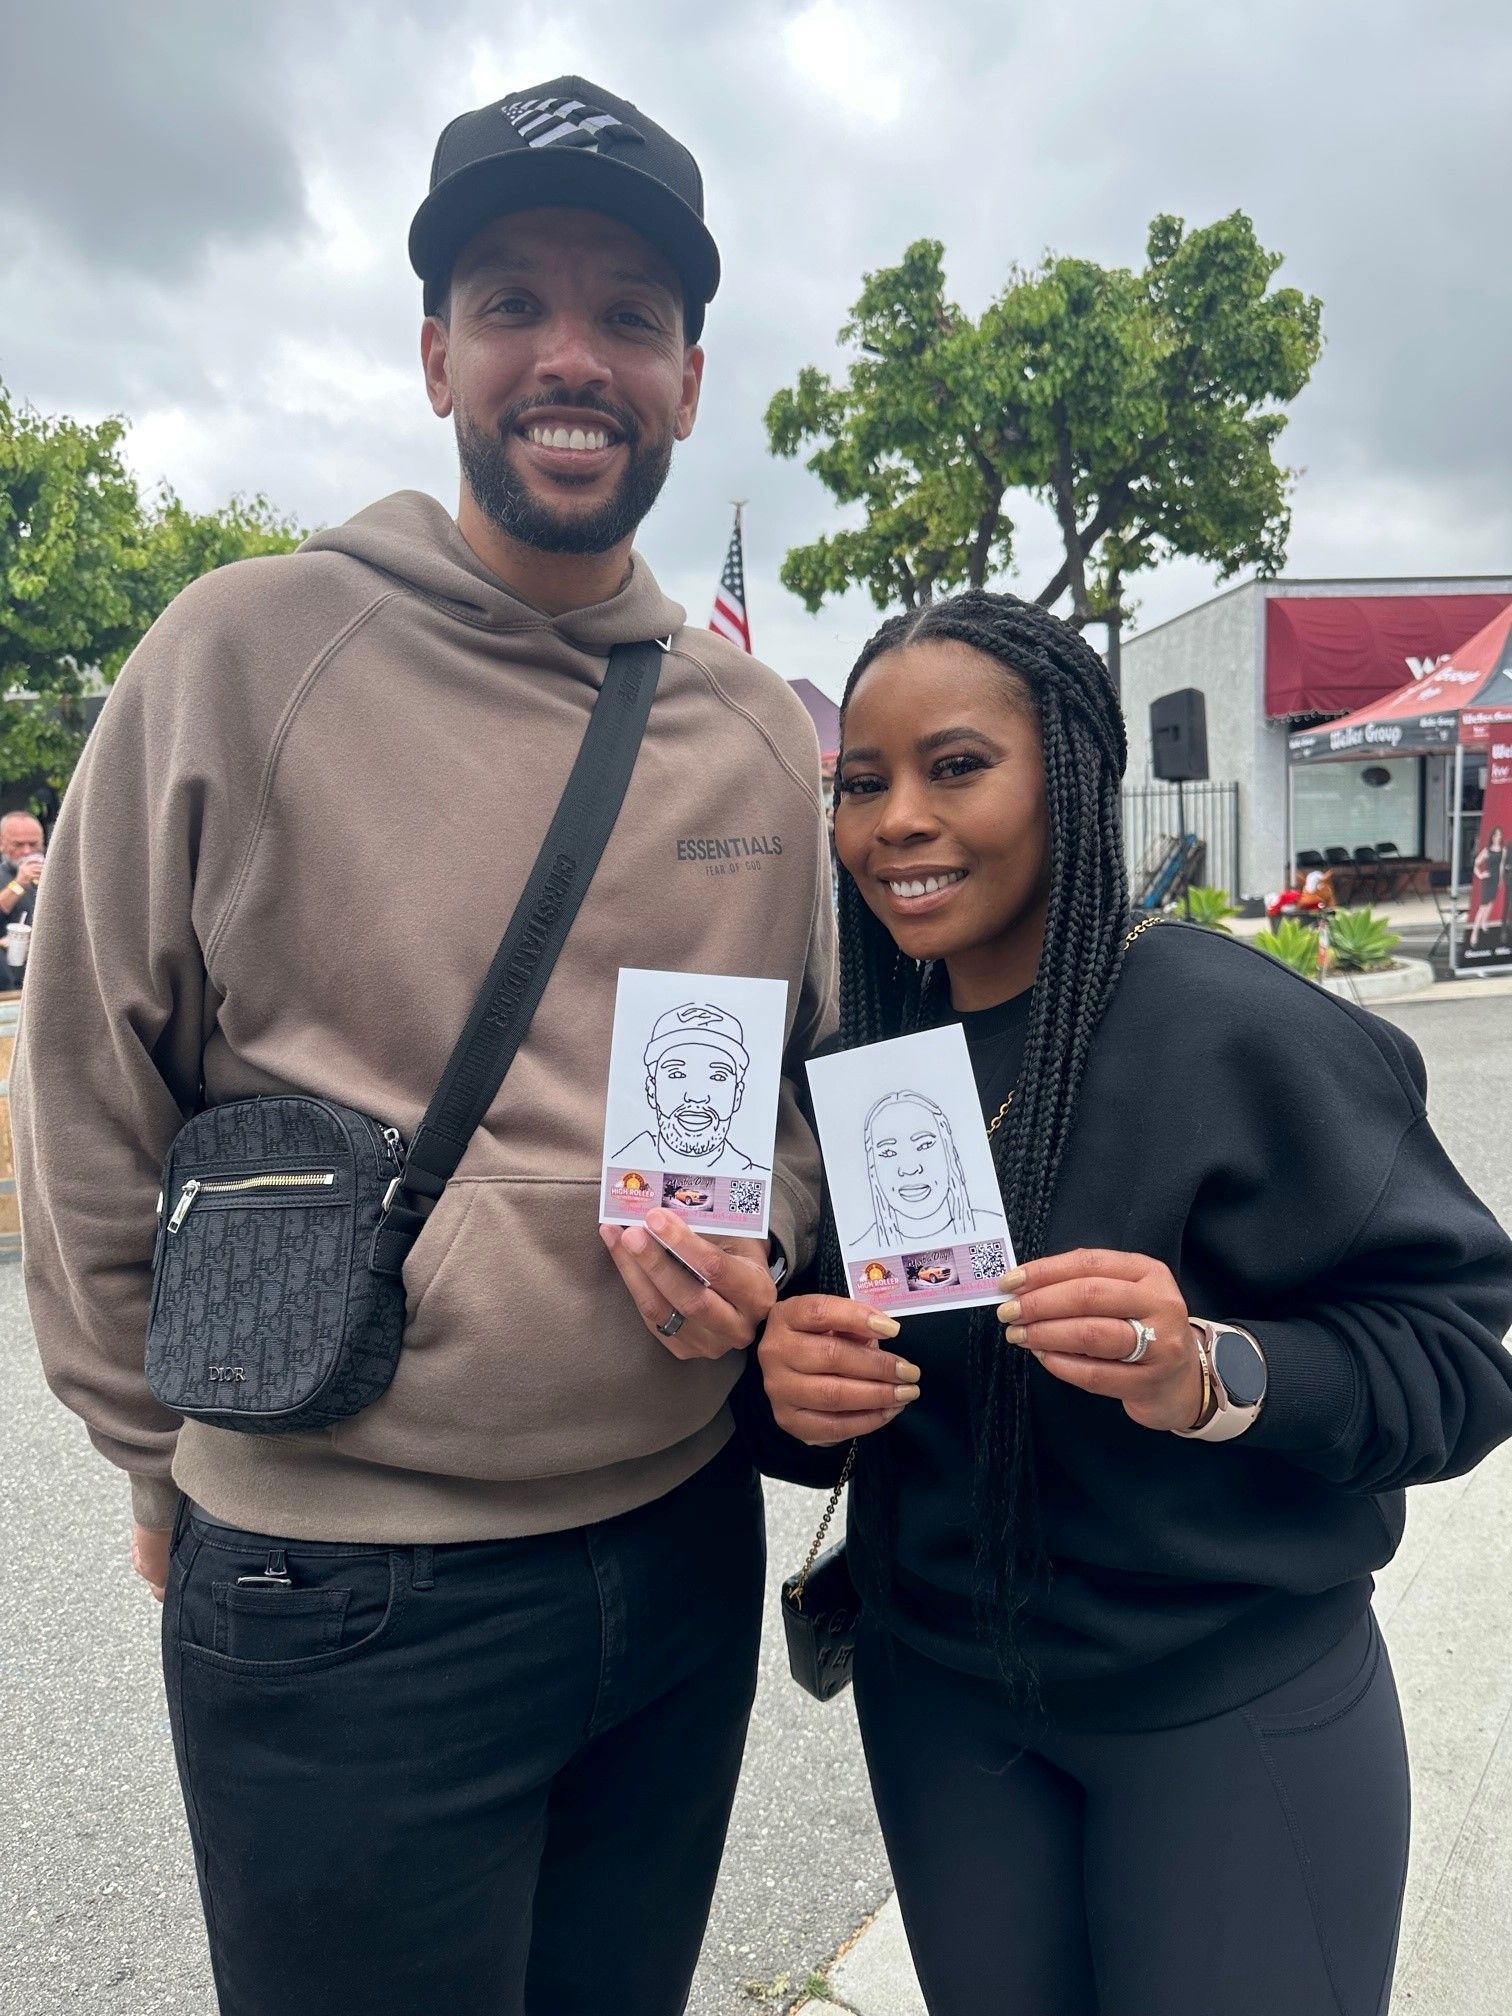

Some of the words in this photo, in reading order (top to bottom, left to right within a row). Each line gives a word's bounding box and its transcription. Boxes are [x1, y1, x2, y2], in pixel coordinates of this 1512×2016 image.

[1365, 723, 1401, 747] Group
[677, 836, 783, 861] ESSENTIALS
[705, 864, 726, 876] FEAR
[729, 863, 740, 874] OF
[746, 861, 762, 872] GOD
[611, 1188, 628, 1196] HIGH
[629, 1189, 655, 1198] ROLLER
[857, 1281, 873, 1290] HIGH
[874, 1278, 899, 1288] ROLLER
[208, 1366, 245, 1381] DIOR
